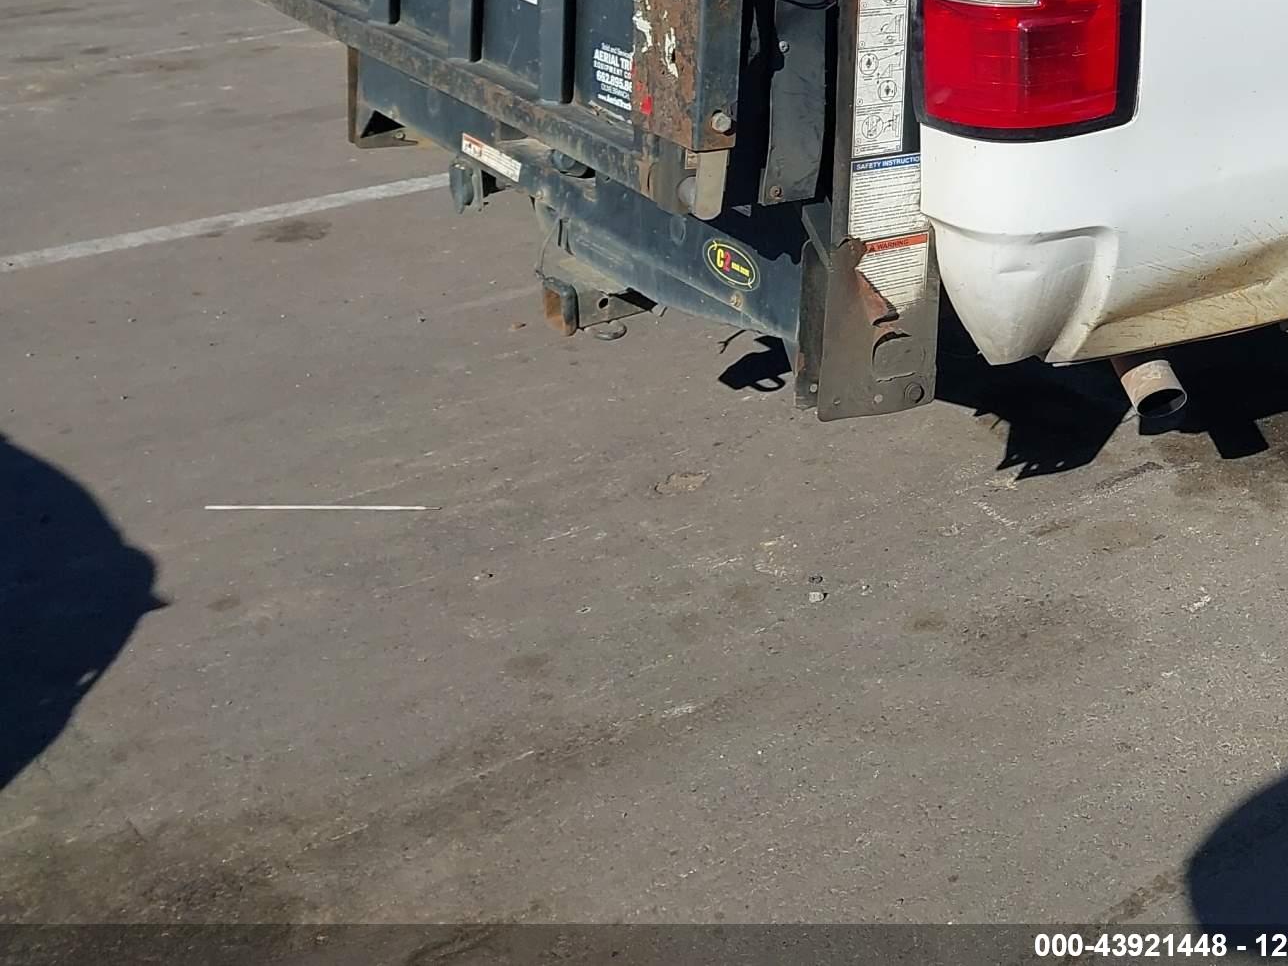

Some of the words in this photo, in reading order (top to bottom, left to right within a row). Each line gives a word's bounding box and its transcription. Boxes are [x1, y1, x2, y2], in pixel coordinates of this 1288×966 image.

[593, 48, 620, 68] AERIAL
[593, 60, 623, 77] EQUIPMENT
[856, 160, 881, 171] SAFETY
[877, 238, 909, 251] WARNING
